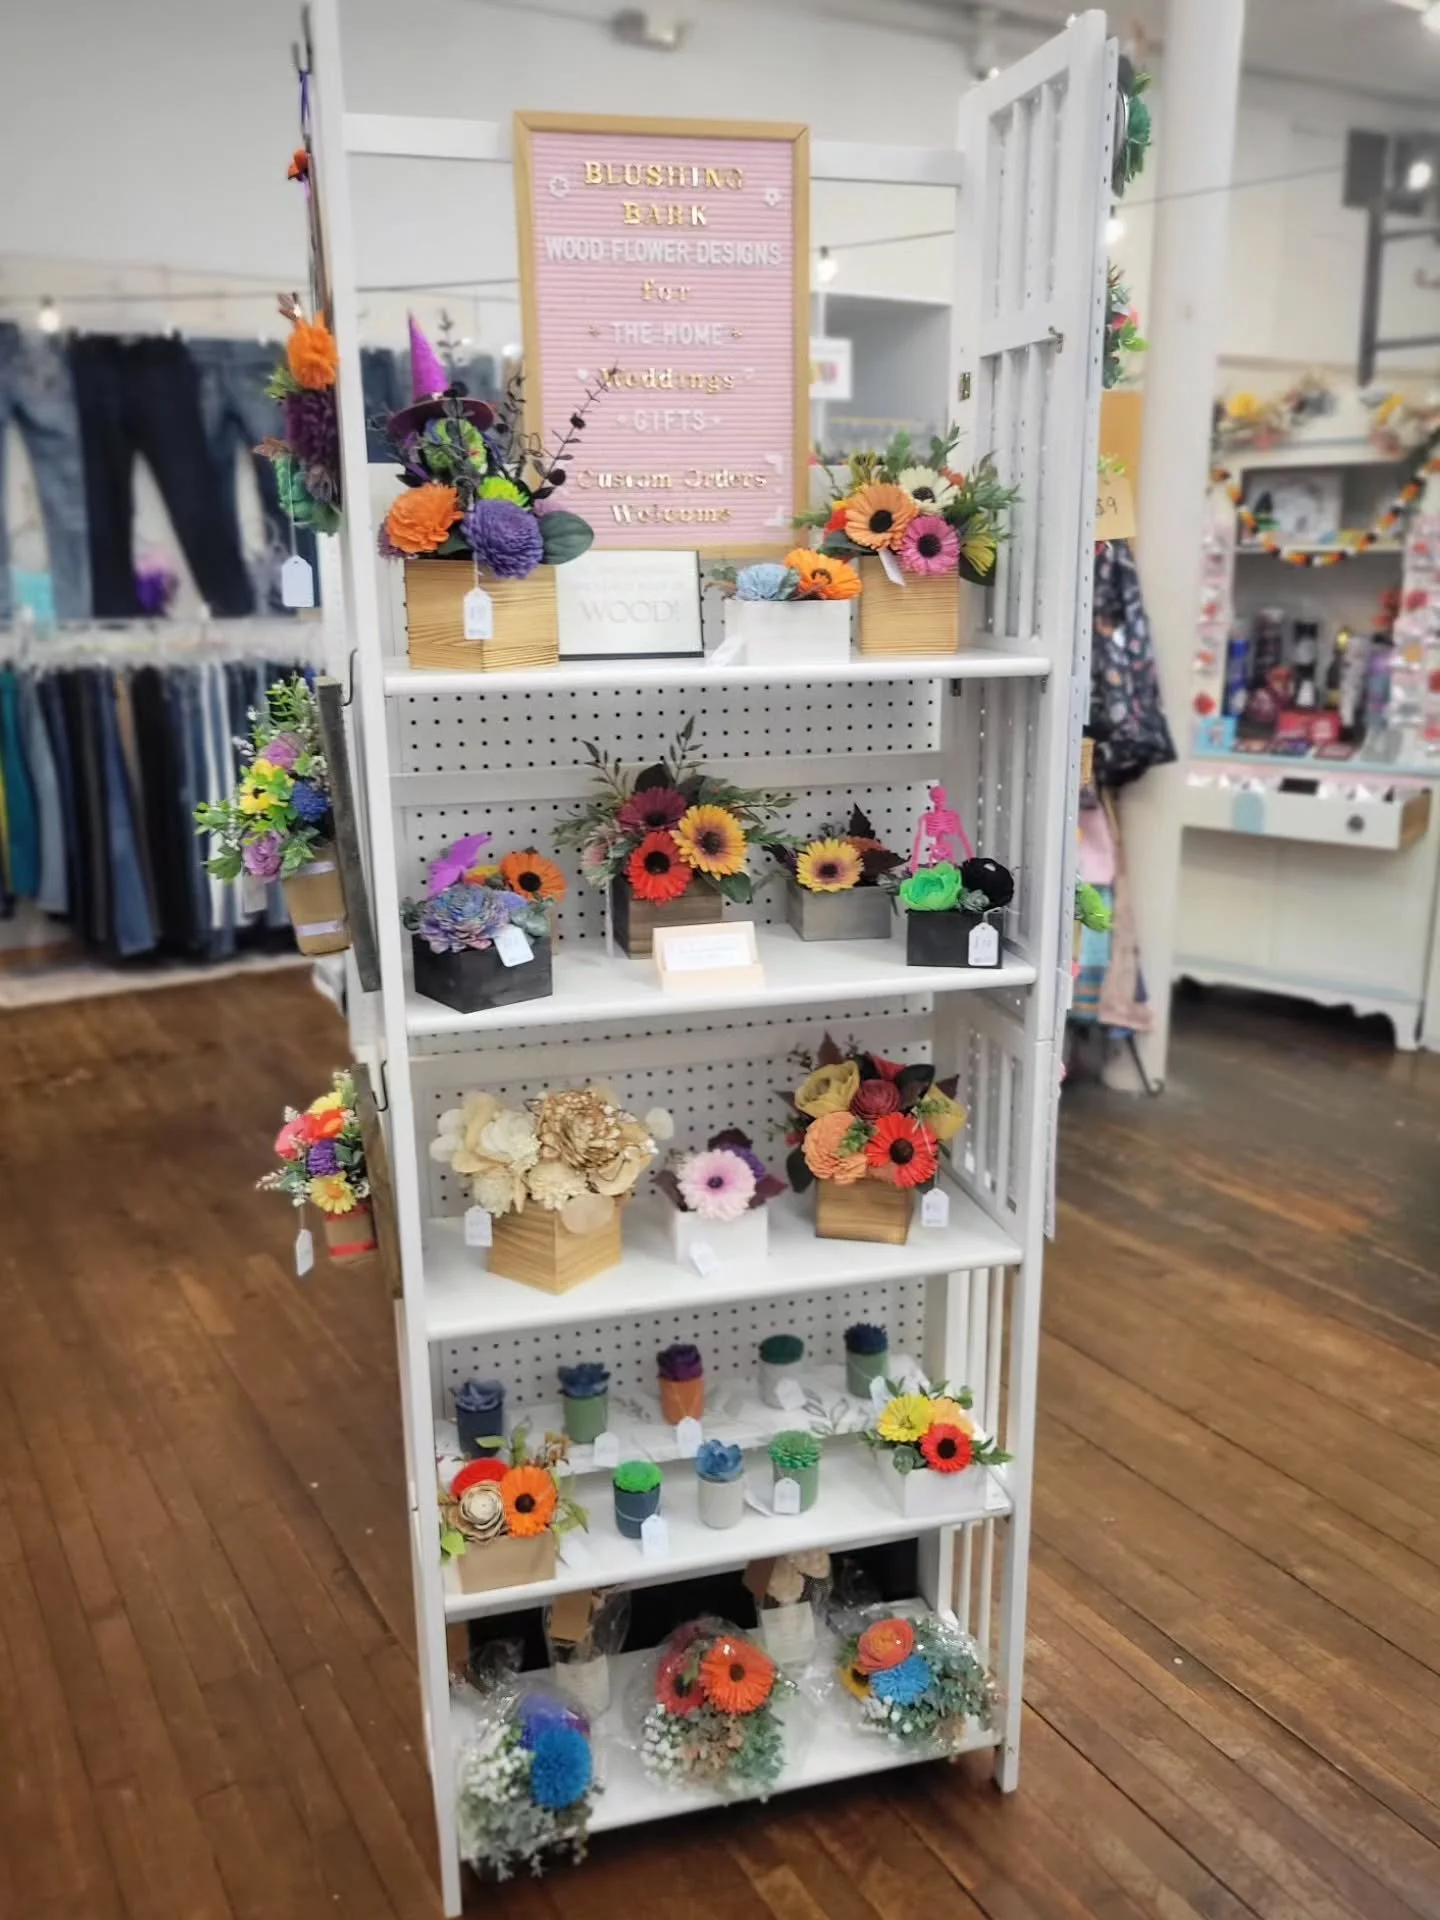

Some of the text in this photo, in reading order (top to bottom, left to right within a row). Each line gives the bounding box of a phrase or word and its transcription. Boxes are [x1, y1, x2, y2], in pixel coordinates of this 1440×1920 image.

[583, 161, 744, 189] BLUSHING
[623, 202, 707, 226] BARK
[545, 235, 783, 266] WOOD FLOWER DESIGNS
[610, 321, 724, 346] THE HOME
[600, 367, 736, 394] Weddings
[634, 409, 706, 432] GIFTS
[576, 467, 768, 489] Custom Orders
[611, 503, 731, 525] Welcome
